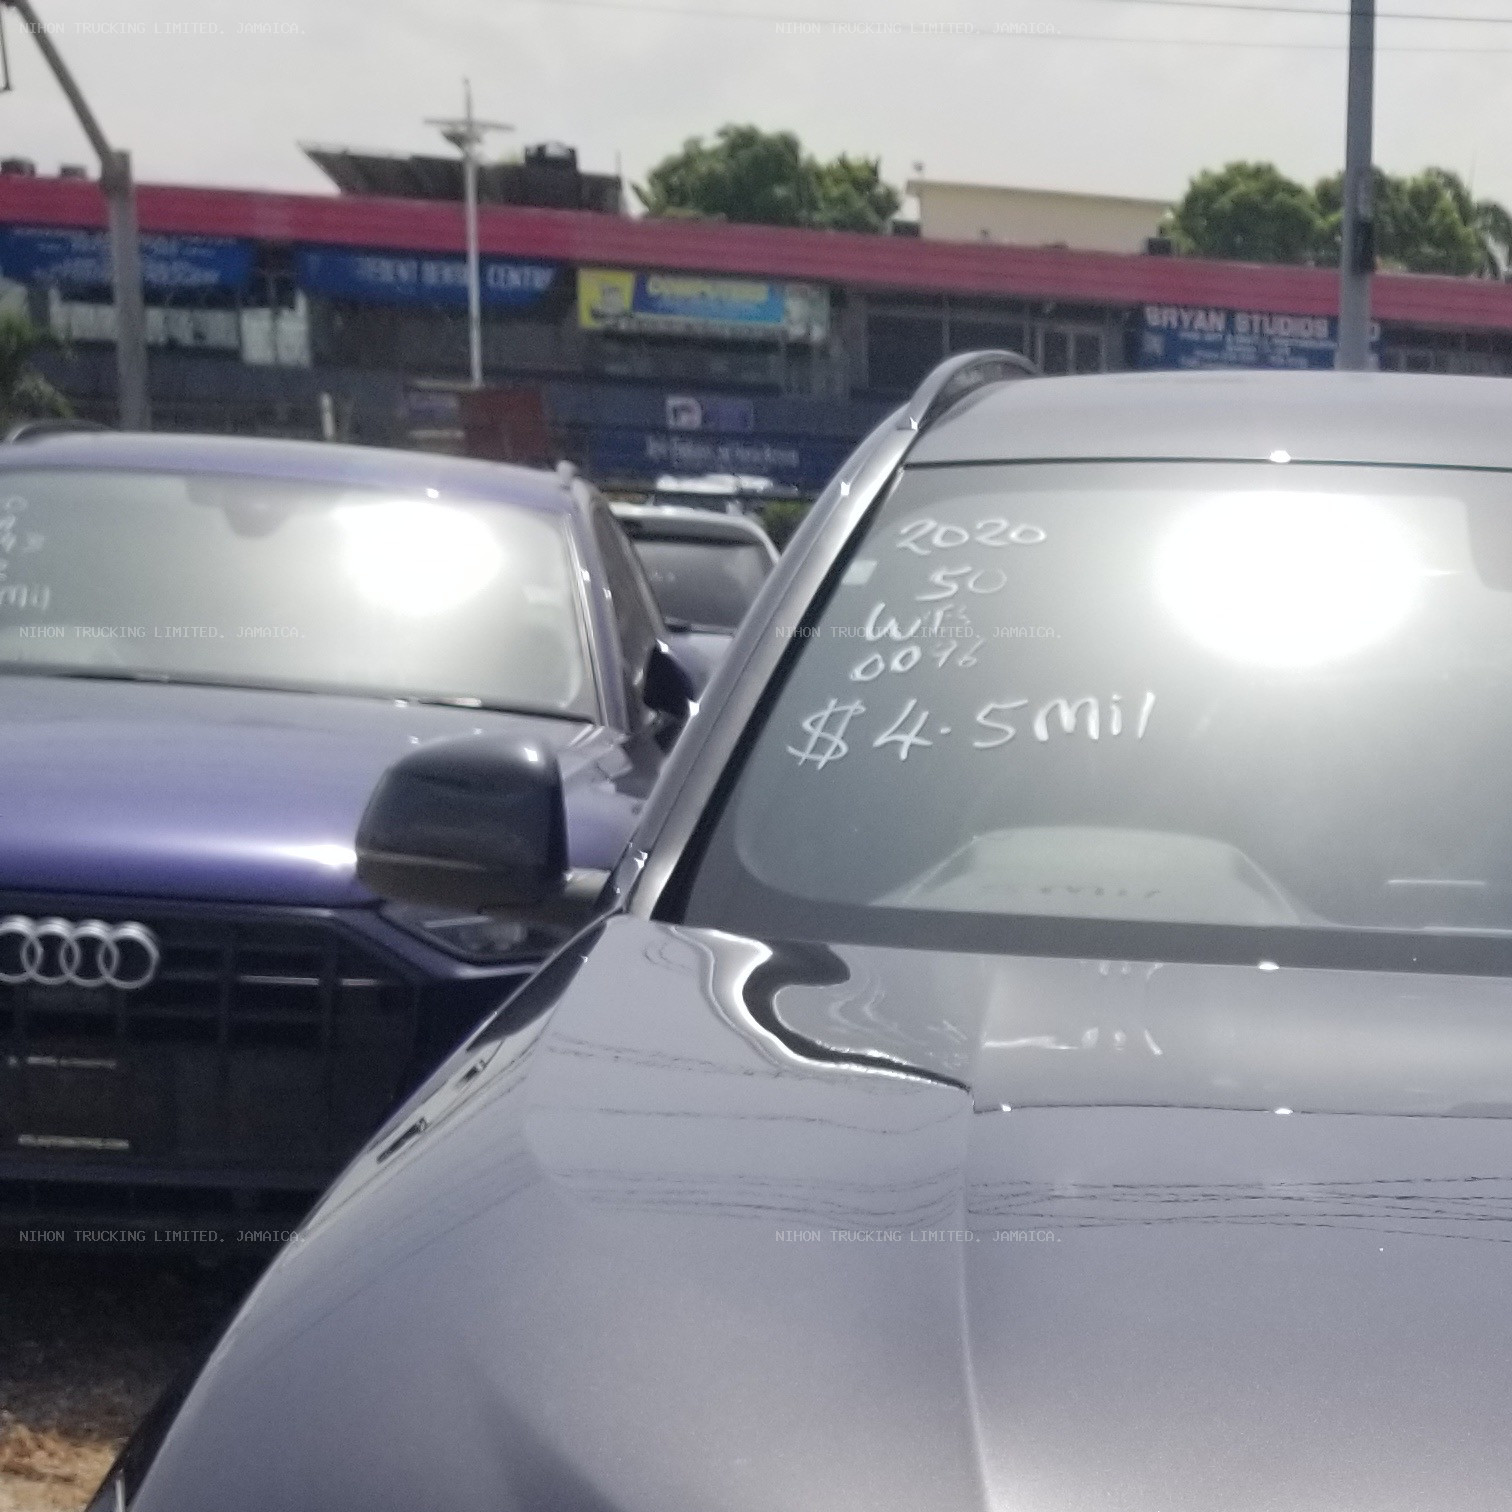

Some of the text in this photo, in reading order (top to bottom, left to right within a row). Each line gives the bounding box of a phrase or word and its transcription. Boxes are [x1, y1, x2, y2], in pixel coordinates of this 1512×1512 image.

[1145, 306, 1329, 338] BRYAN STUDIOS
[896, 518, 1048, 556] 2020
[915, 565, 1008, 601] 50
